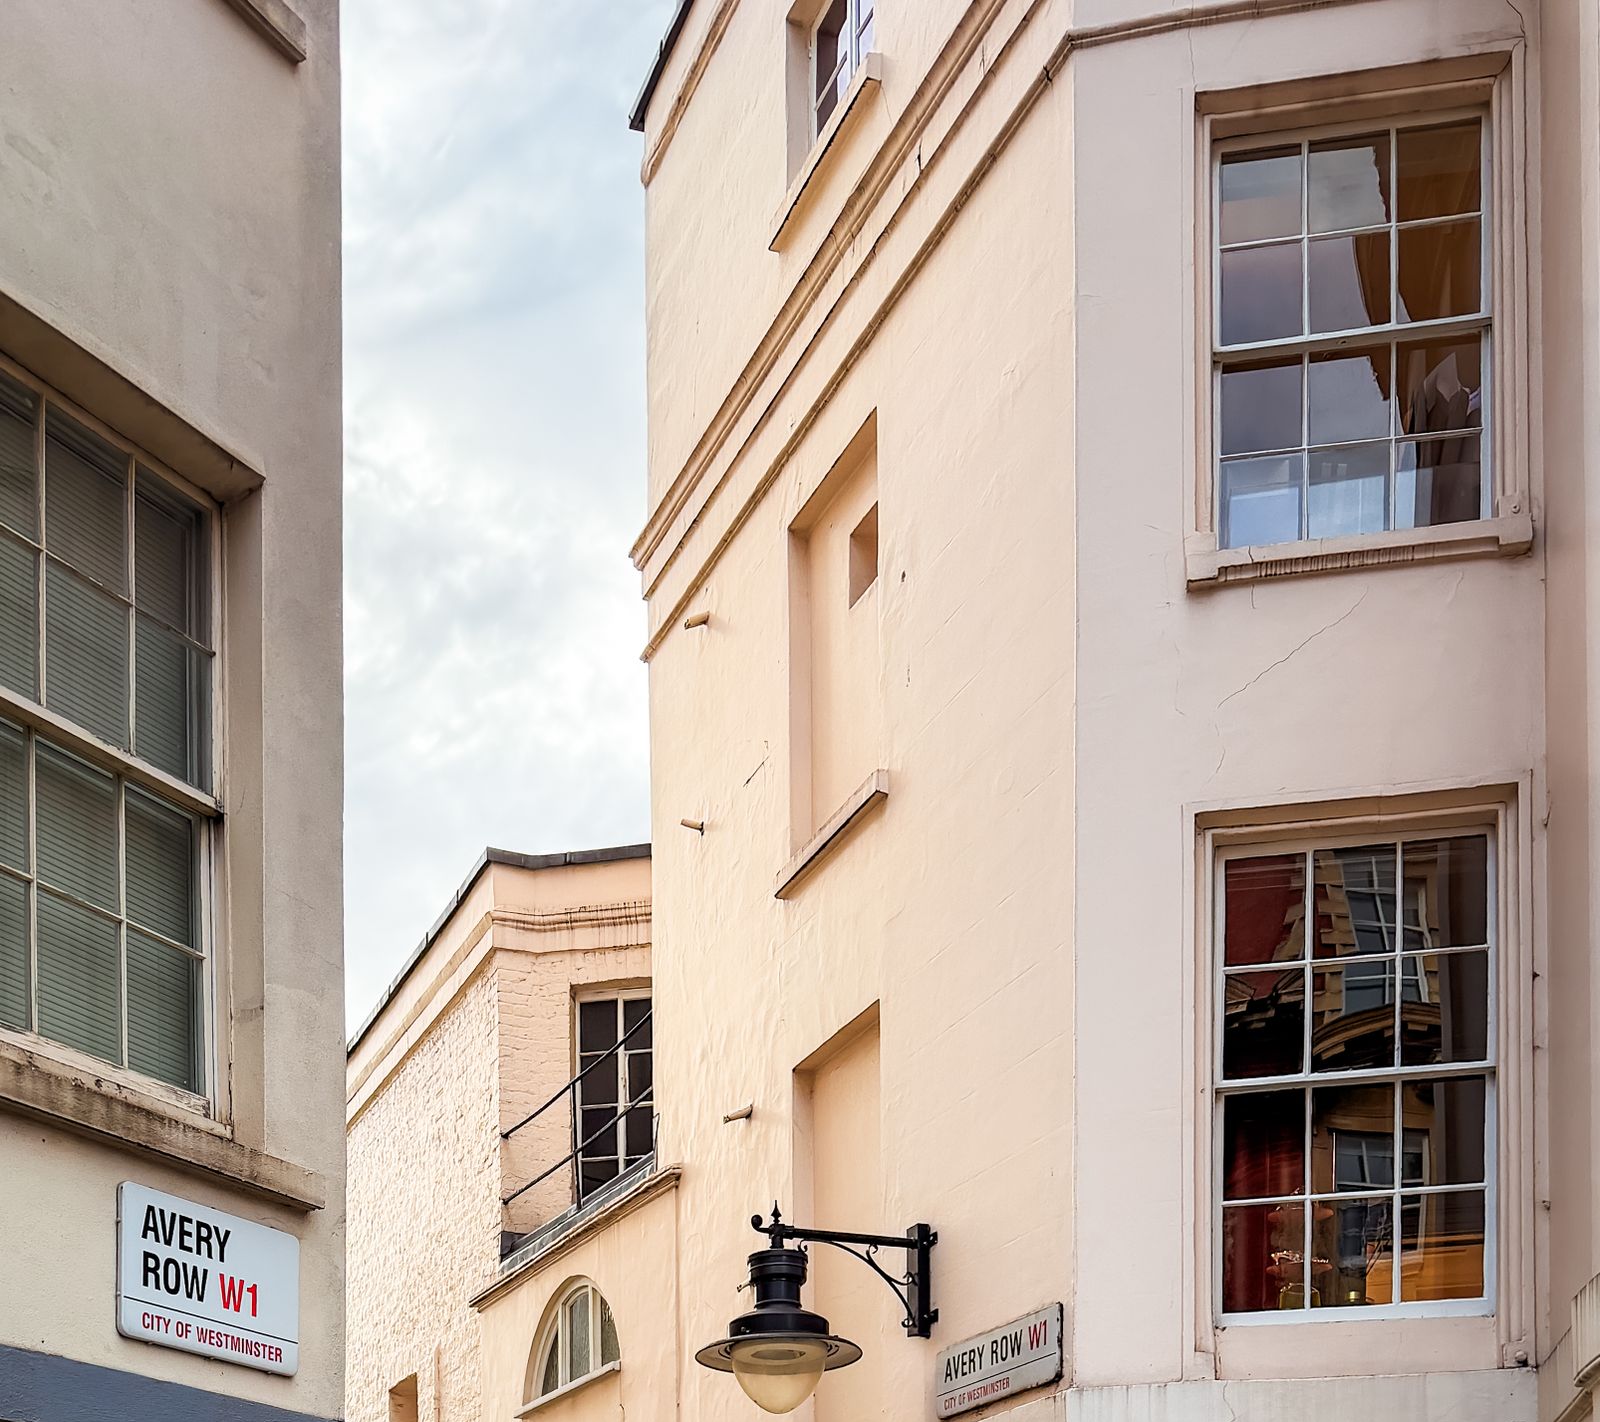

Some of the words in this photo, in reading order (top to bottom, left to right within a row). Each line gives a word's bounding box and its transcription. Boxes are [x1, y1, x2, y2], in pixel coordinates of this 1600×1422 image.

[141, 1204, 231, 1263] AVERY
[142, 1250, 209, 1303] ROW
[219, 1273, 259, 1318] W1
[141, 1311, 171, 1334] CITY
[175, 1320, 192, 1339] OF
[196, 1326, 283, 1363] WESTMINSTER
[944, 1344, 985, 1383] AVERY
[990, 1329, 1023, 1366] ROW
[1028, 1319, 1048, 1350] W1
[943, 1397, 957, 1411] CITY
[958, 1394, 967, 1406] OF
[967, 1377, 1010, 1402] WESTMINSTER
